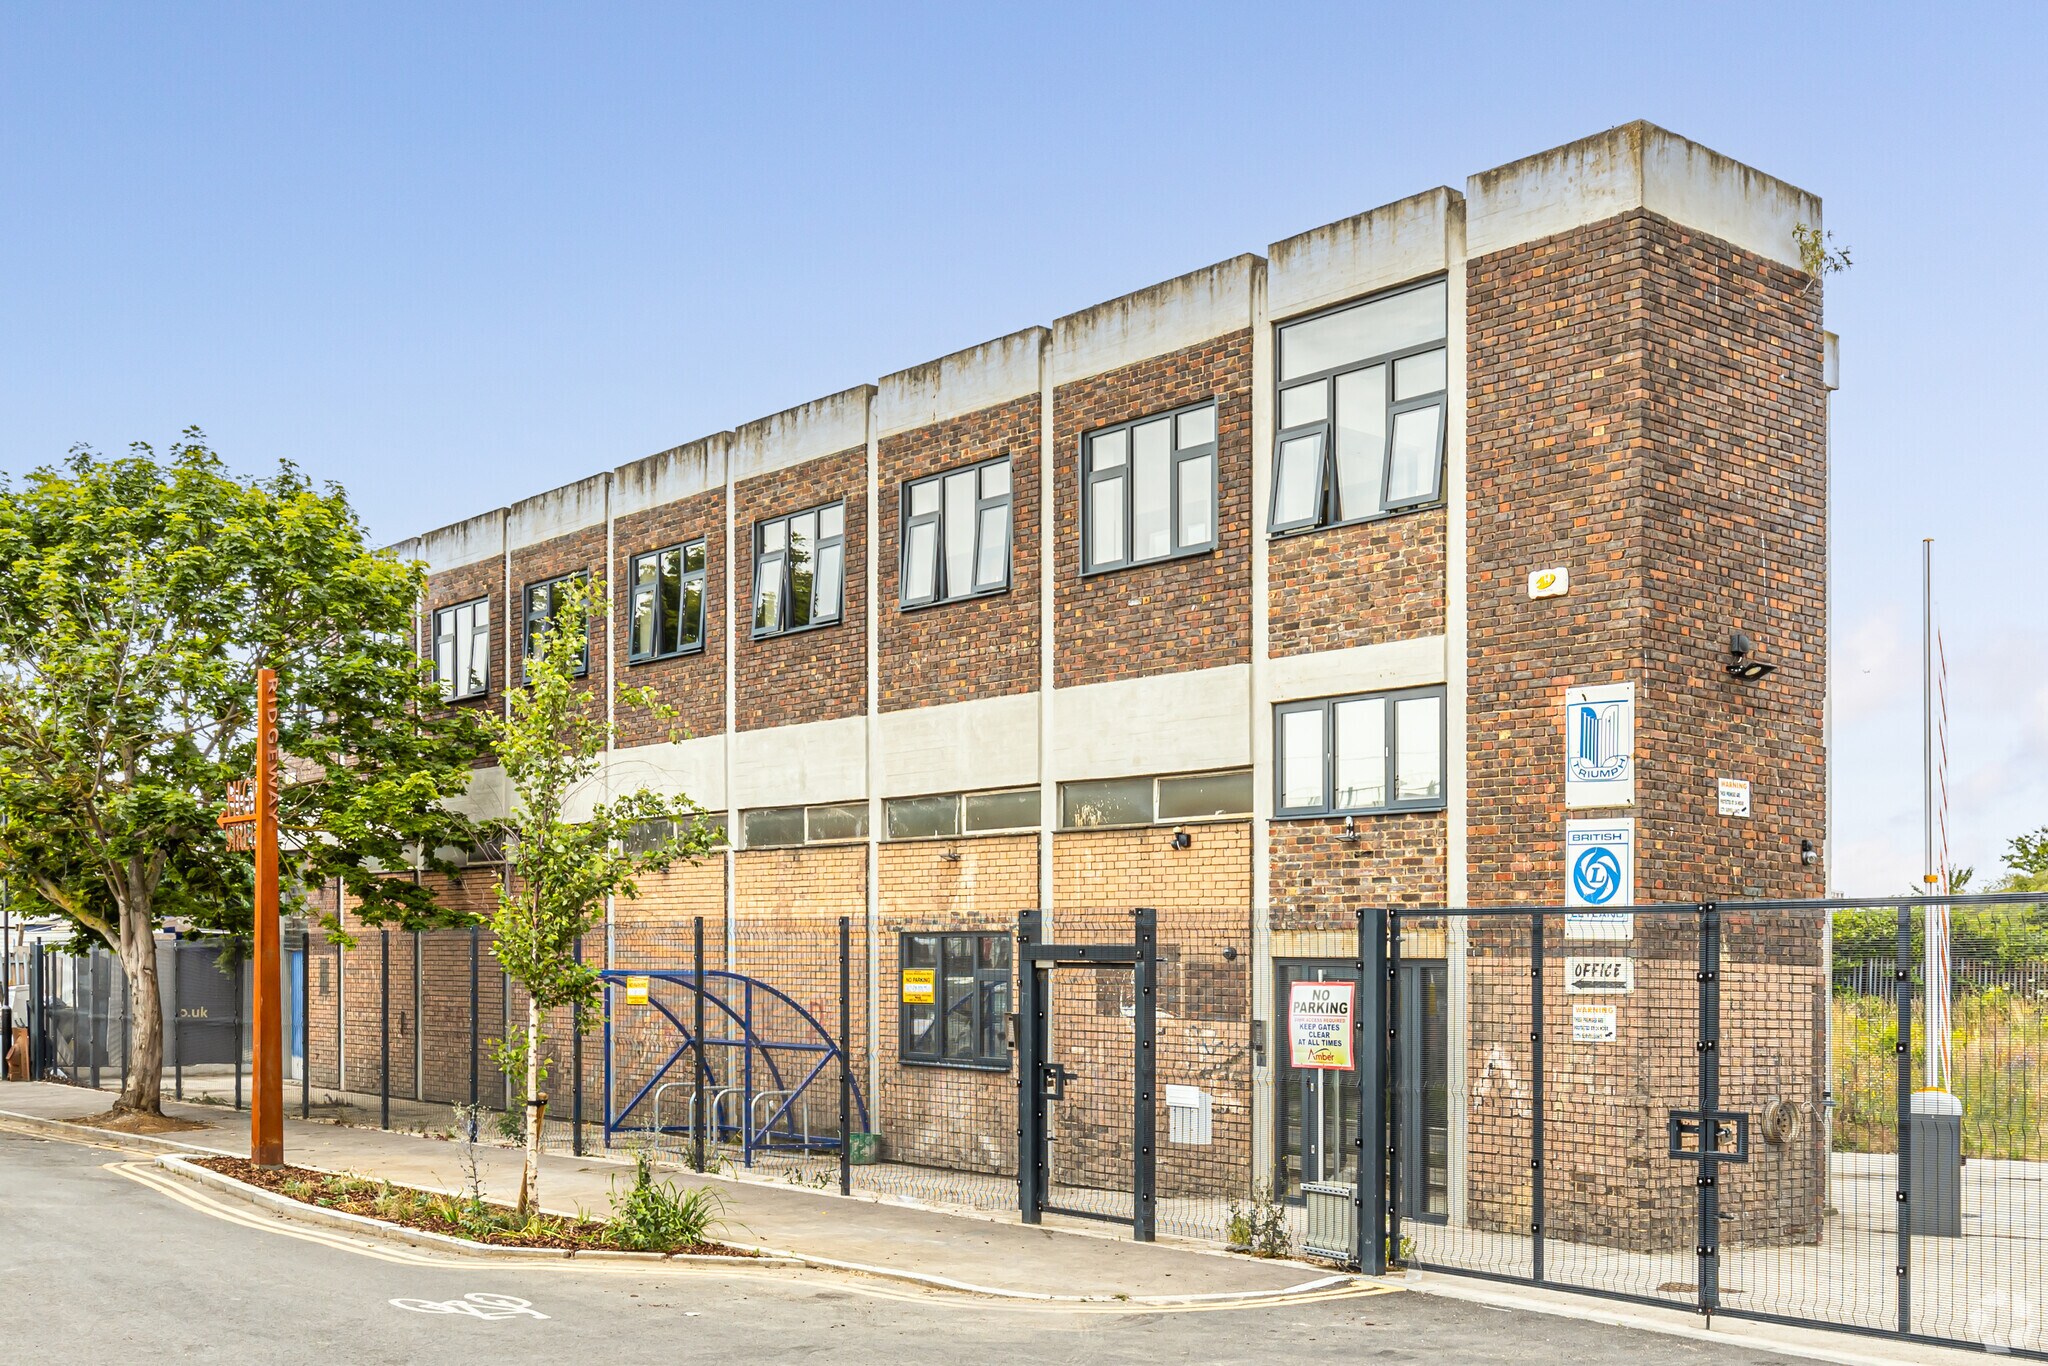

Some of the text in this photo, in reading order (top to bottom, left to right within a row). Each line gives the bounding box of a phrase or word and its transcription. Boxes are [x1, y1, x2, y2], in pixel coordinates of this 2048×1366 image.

[267, 677, 279, 821] RIDGEWAY
[1573, 757, 1626, 779] TRIUMPH
[1720, 781, 1748, 790] WARNING
[1572, 833, 1622, 842] BRITISH
[1590, 867, 1606, 884] L
[1574, 963, 1621, 977] OFFICE
[1312, 989, 1330, 1001] NO
[1293, 1001, 1348, 1014] PARKING
[1575, 1006, 1614, 1014] WARNING
[1308, 1048, 1334, 1060] Amber
